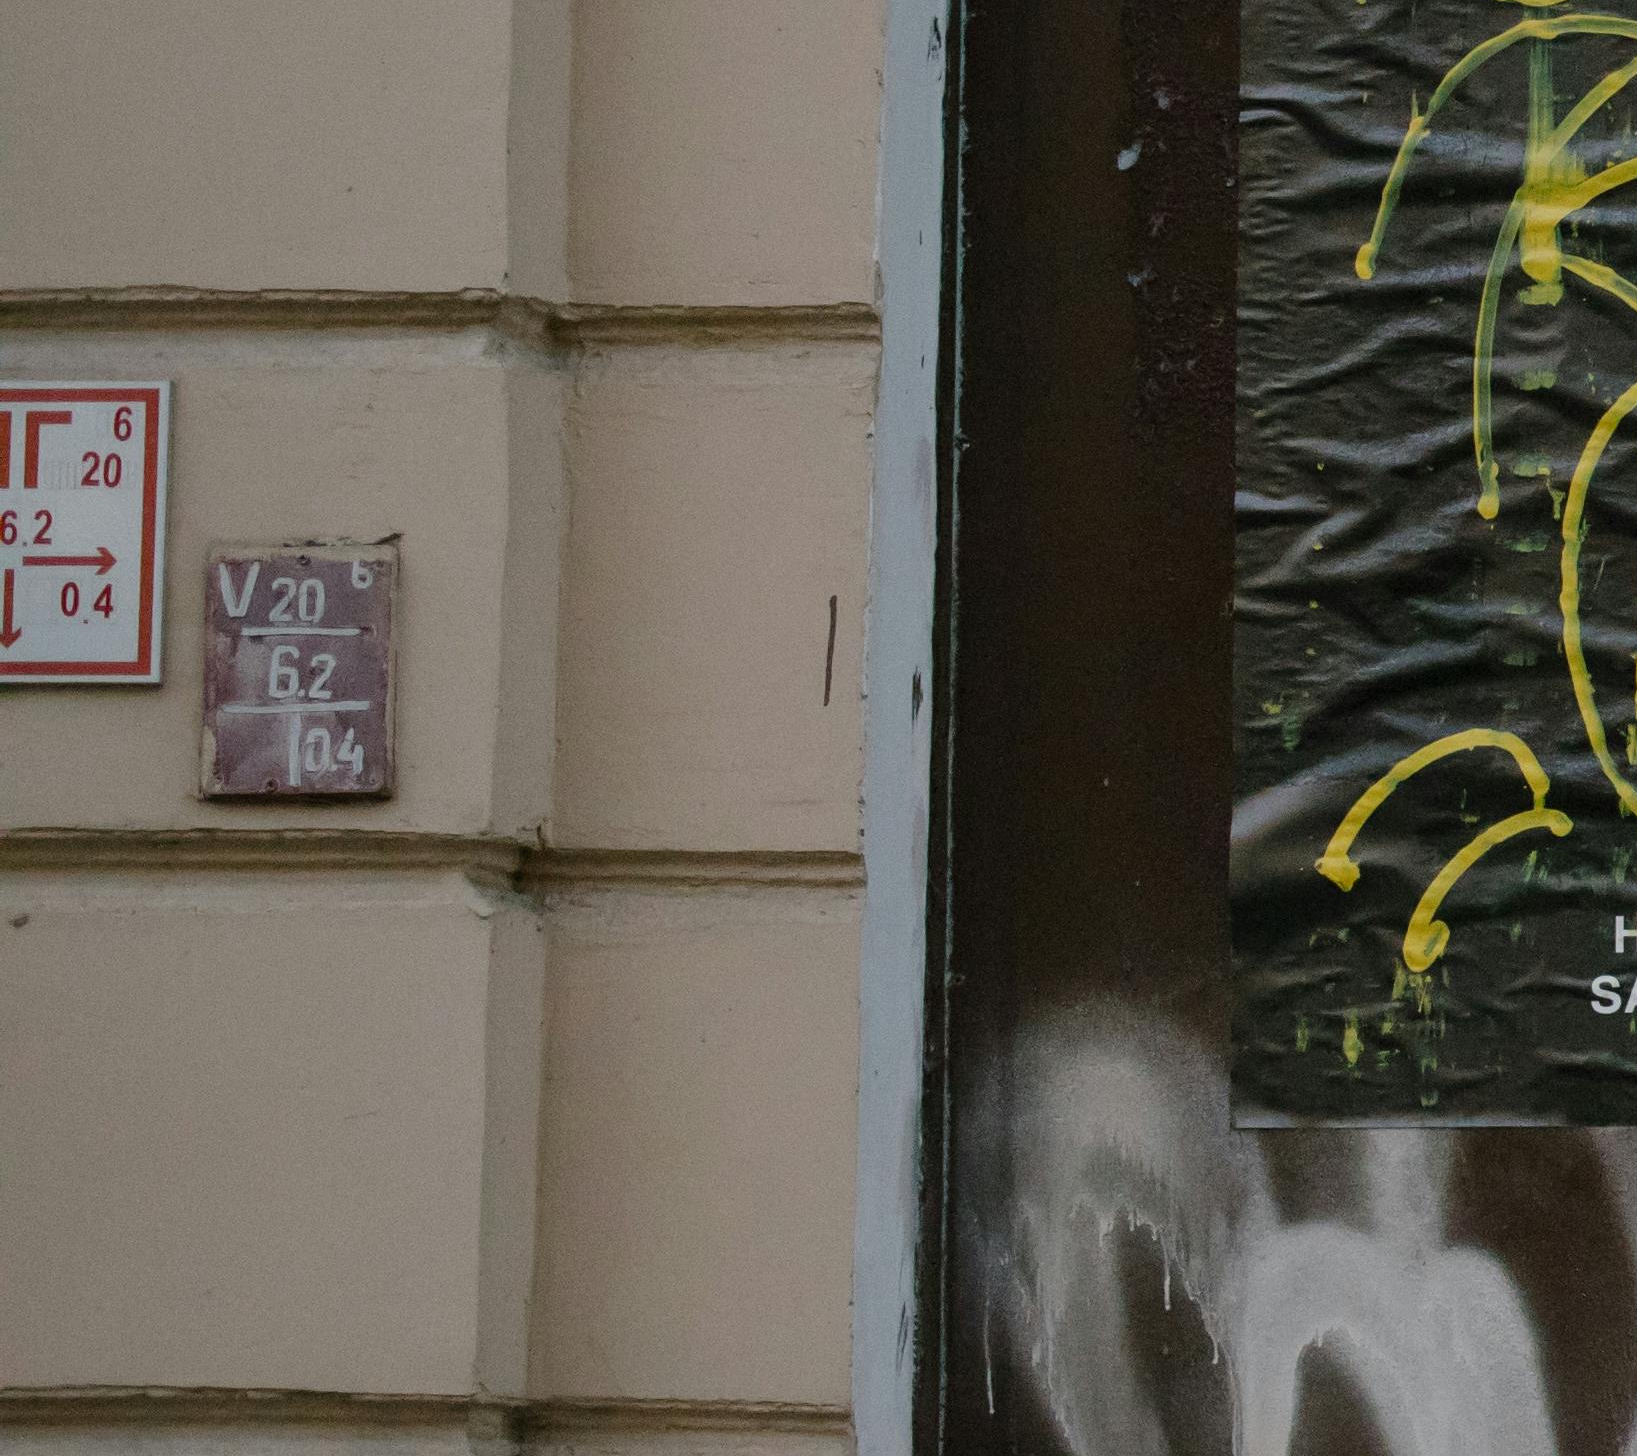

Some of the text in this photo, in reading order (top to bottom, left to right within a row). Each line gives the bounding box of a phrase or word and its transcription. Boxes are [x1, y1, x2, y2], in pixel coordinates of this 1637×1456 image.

[113, 406, 133, 441] 6
[0, 411, 72, 489] Г
[81, 451, 122, 488] 20
[60, 581, 114, 624] 0.4
[268, 645, 337, 699] 6.2
